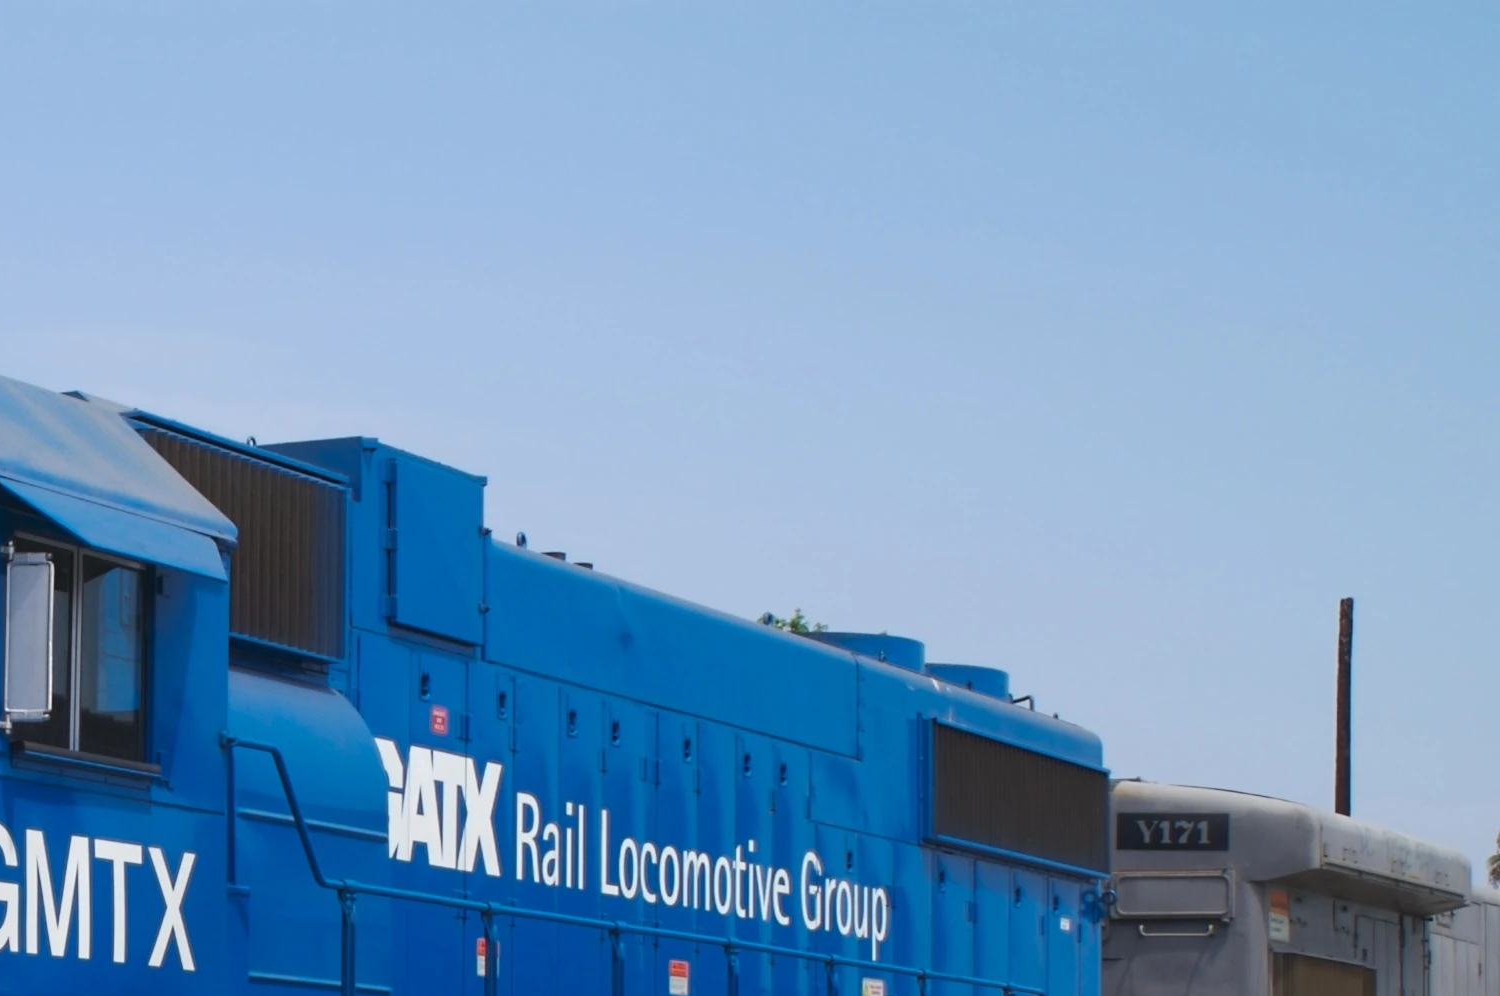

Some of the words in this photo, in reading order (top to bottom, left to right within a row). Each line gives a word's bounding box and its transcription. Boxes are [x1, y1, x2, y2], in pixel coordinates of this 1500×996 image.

[515, 791, 586, 890] Rail
[600, 808, 791, 926] Locomotive
[800, 850, 889, 961] Group
[1136, 819, 1212, 845] Y171
